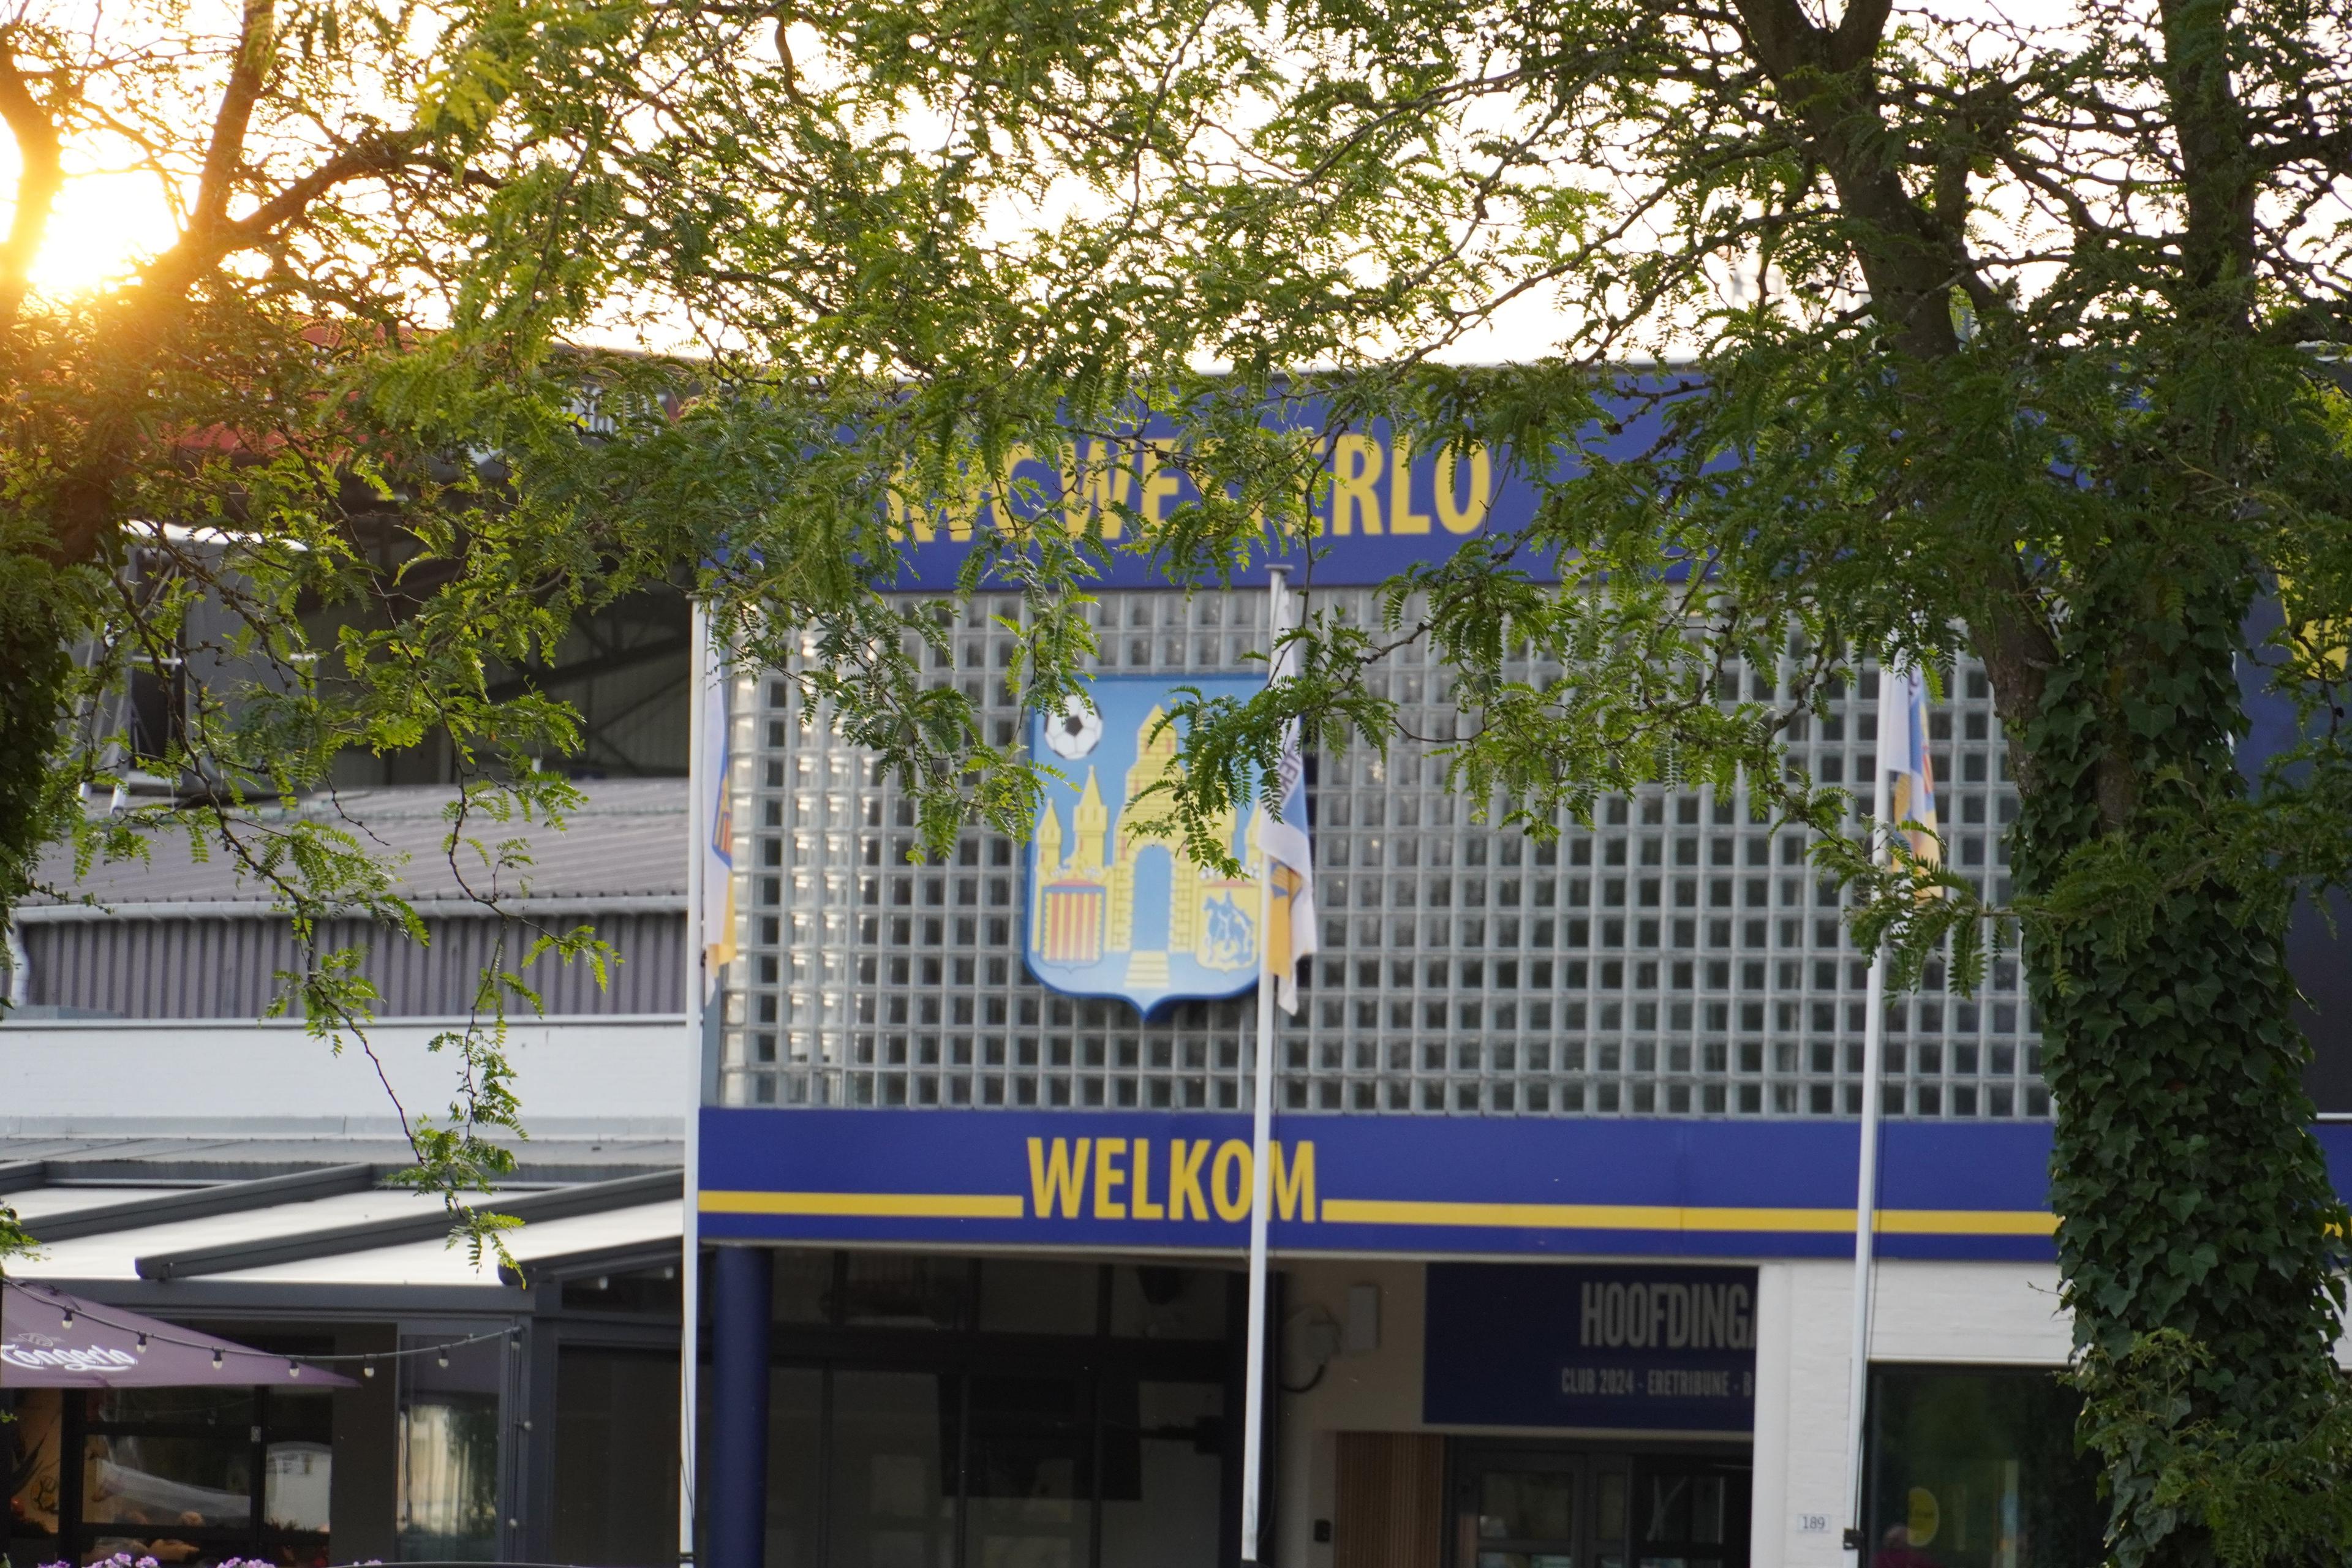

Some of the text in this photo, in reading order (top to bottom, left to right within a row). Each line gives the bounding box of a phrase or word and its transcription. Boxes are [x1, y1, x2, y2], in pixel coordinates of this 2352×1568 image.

[1027, 1136, 1316, 1223] WELKOM
[1580, 1281, 1757, 1349] HOOFDING
[1561, 1367, 1596, 1394] CLUB
[1599, 1369, 1634, 1395] 2024
[1803, 1516, 1825, 1529] 189
